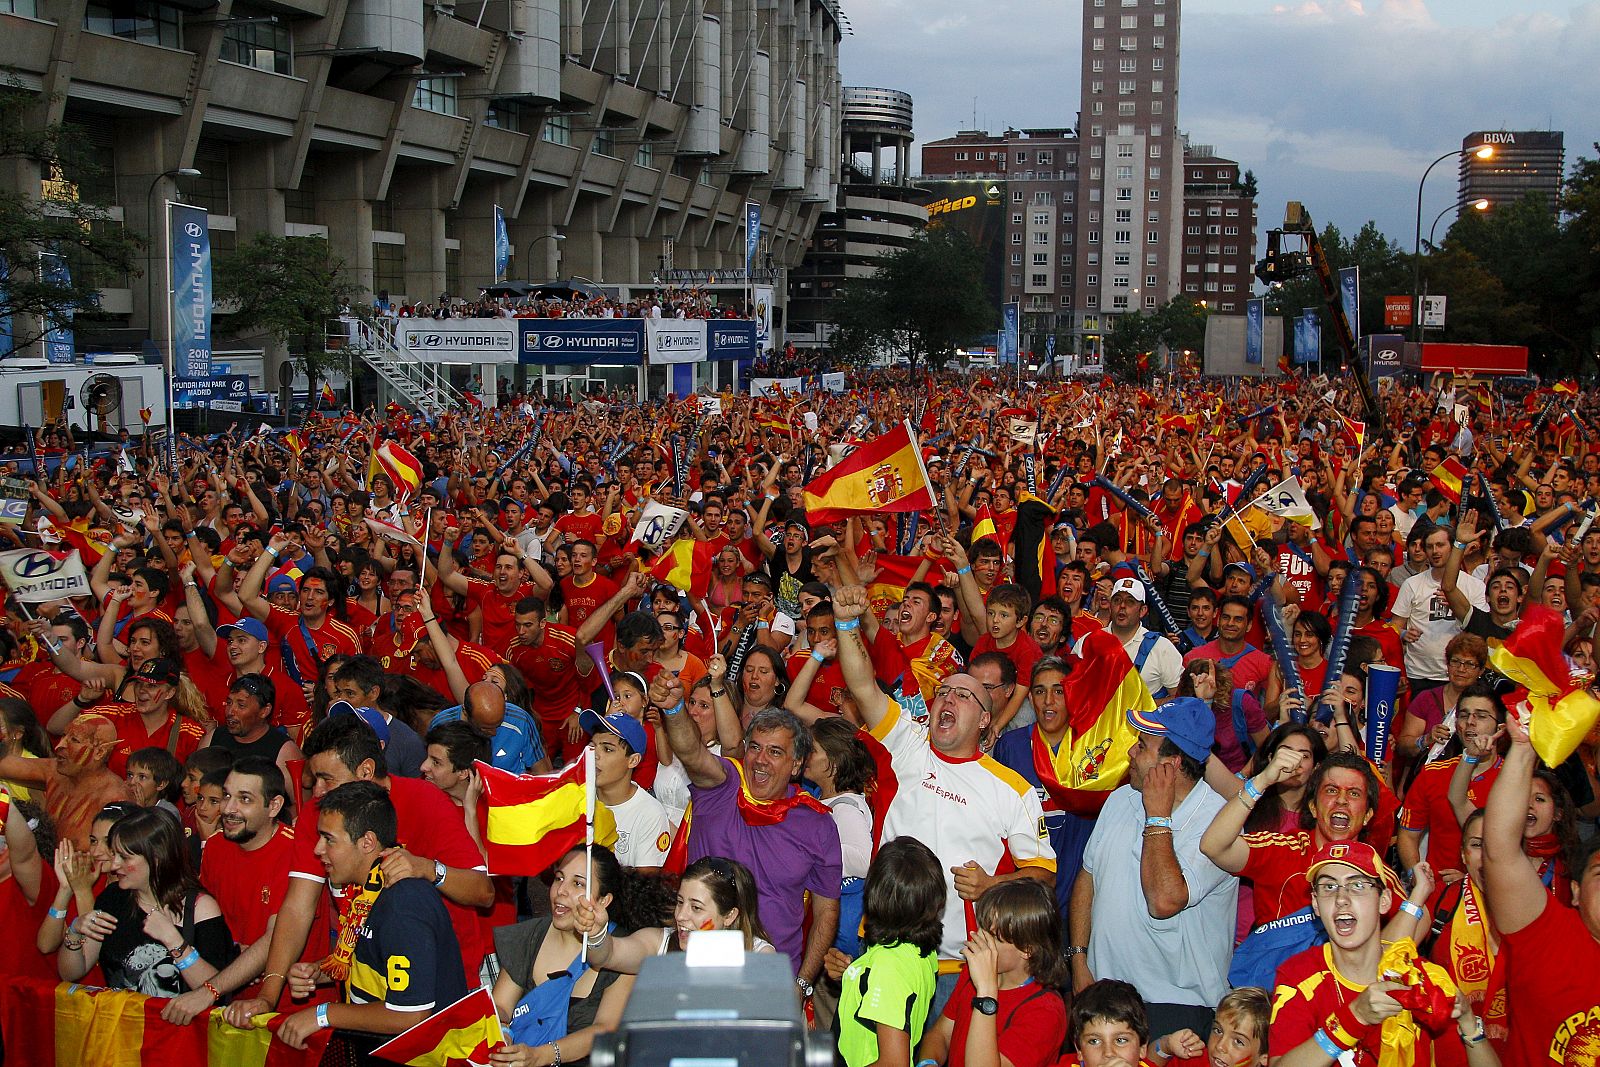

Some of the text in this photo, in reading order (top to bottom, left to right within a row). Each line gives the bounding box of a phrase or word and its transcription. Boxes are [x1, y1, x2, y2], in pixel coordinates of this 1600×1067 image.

[1483, 133, 1516, 144] BBVA
[928, 195, 977, 216] SPEED
[190, 243, 206, 340] HYUNDAI
[446, 336, 494, 346] HYUNDAI
[566, 337, 619, 347] HYUNDAI
[673, 336, 694, 346] HYUNDAI
[727, 335, 744, 345] HYUNDAI
[188, 348, 209, 359] 2010
[187, 388, 212, 396] MADRID
[211, 380, 228, 388] PARK
[1149, 586, 1183, 635] HYUNDAI
[1374, 721, 1386, 769] HYUNDA
[935, 786, 967, 806] ESPAÑA
[1269, 913, 1316, 930] HYUNDAI
[386, 955, 411, 991] 6
[1463, 958, 1488, 976] BK
[512, 1003, 530, 1019] DAI
[1269, 984, 1297, 1025] 7
